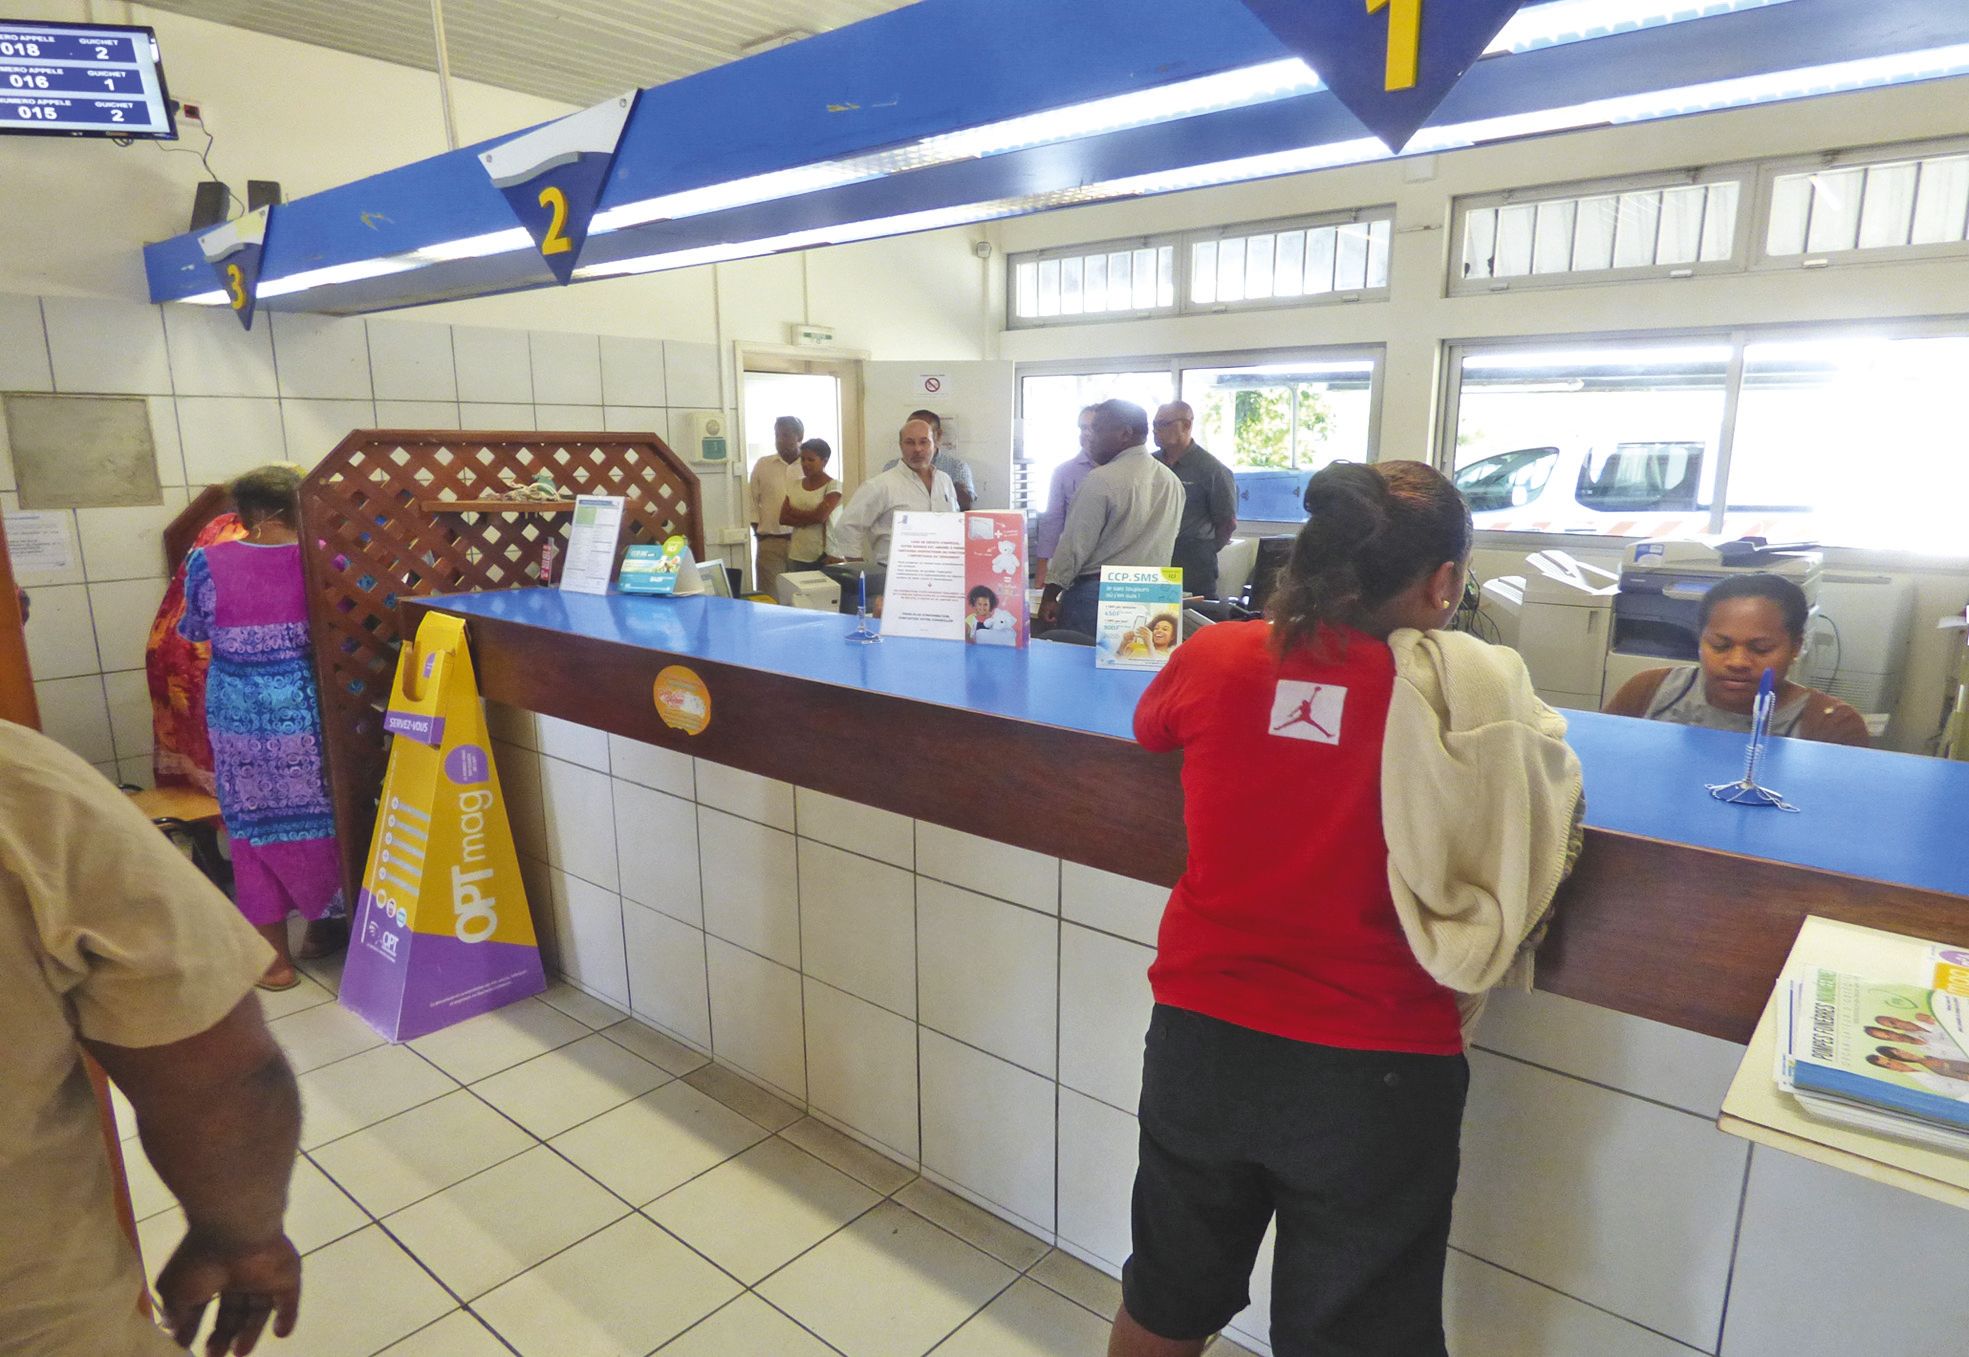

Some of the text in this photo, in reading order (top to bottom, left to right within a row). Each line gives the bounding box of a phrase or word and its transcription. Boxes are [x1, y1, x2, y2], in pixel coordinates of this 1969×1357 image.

[79, 37, 118, 46] GUICHET
[1365, 0, 1421, 93] 1
[0, 42, 40, 57] 018
[95, 46, 109, 60] 2
[9, 74, 49, 88] 016
[87, 70, 126, 78] GUICHET
[104, 78, 115, 91] 1
[18, 105, 57, 119] 015
[94, 101, 133, 109] GUICHET
[111, 109, 125, 122] 2
[538, 186, 572, 255] 2
[226, 263, 246, 310] 3
[389, 717, 429, 733] SERVEZ-VOUS
[458, 789, 494, 863] mag
[451, 865, 498, 943] OPT
[1812, 1034, 1834, 1062] POMPES
